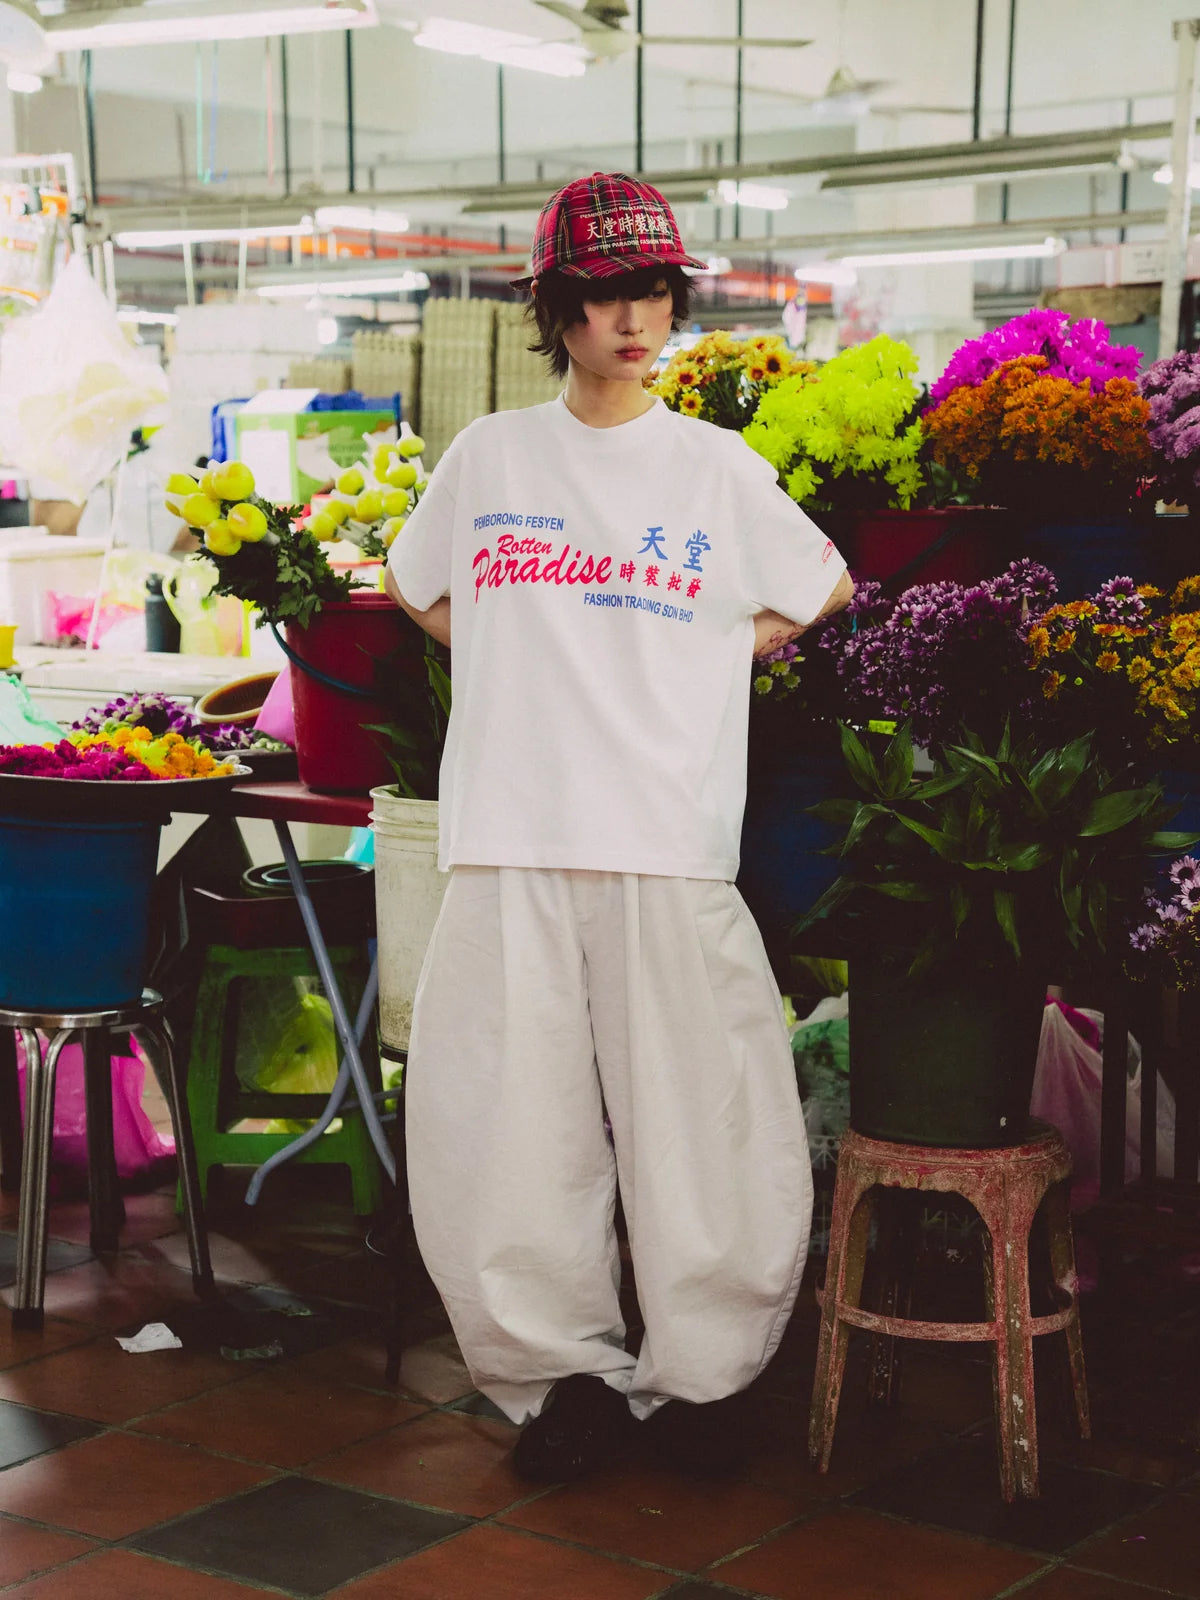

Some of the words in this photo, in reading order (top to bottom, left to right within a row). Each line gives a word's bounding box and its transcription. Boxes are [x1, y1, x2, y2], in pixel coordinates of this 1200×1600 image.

[474, 513, 523, 531] PEMBORONG
[525, 516, 564, 531] FESYEN
[496, 534, 552, 558] Rotten
[637, 526, 711, 573] 天堂
[472, 544, 612, 604] Paradise
[619, 560, 702, 599] 時裝批發
[584, 593, 622, 608] FASHION
[625, 595, 662, 614] TRADING
[662, 604, 678, 619] SDN
[679, 608, 693, 623] BHD
